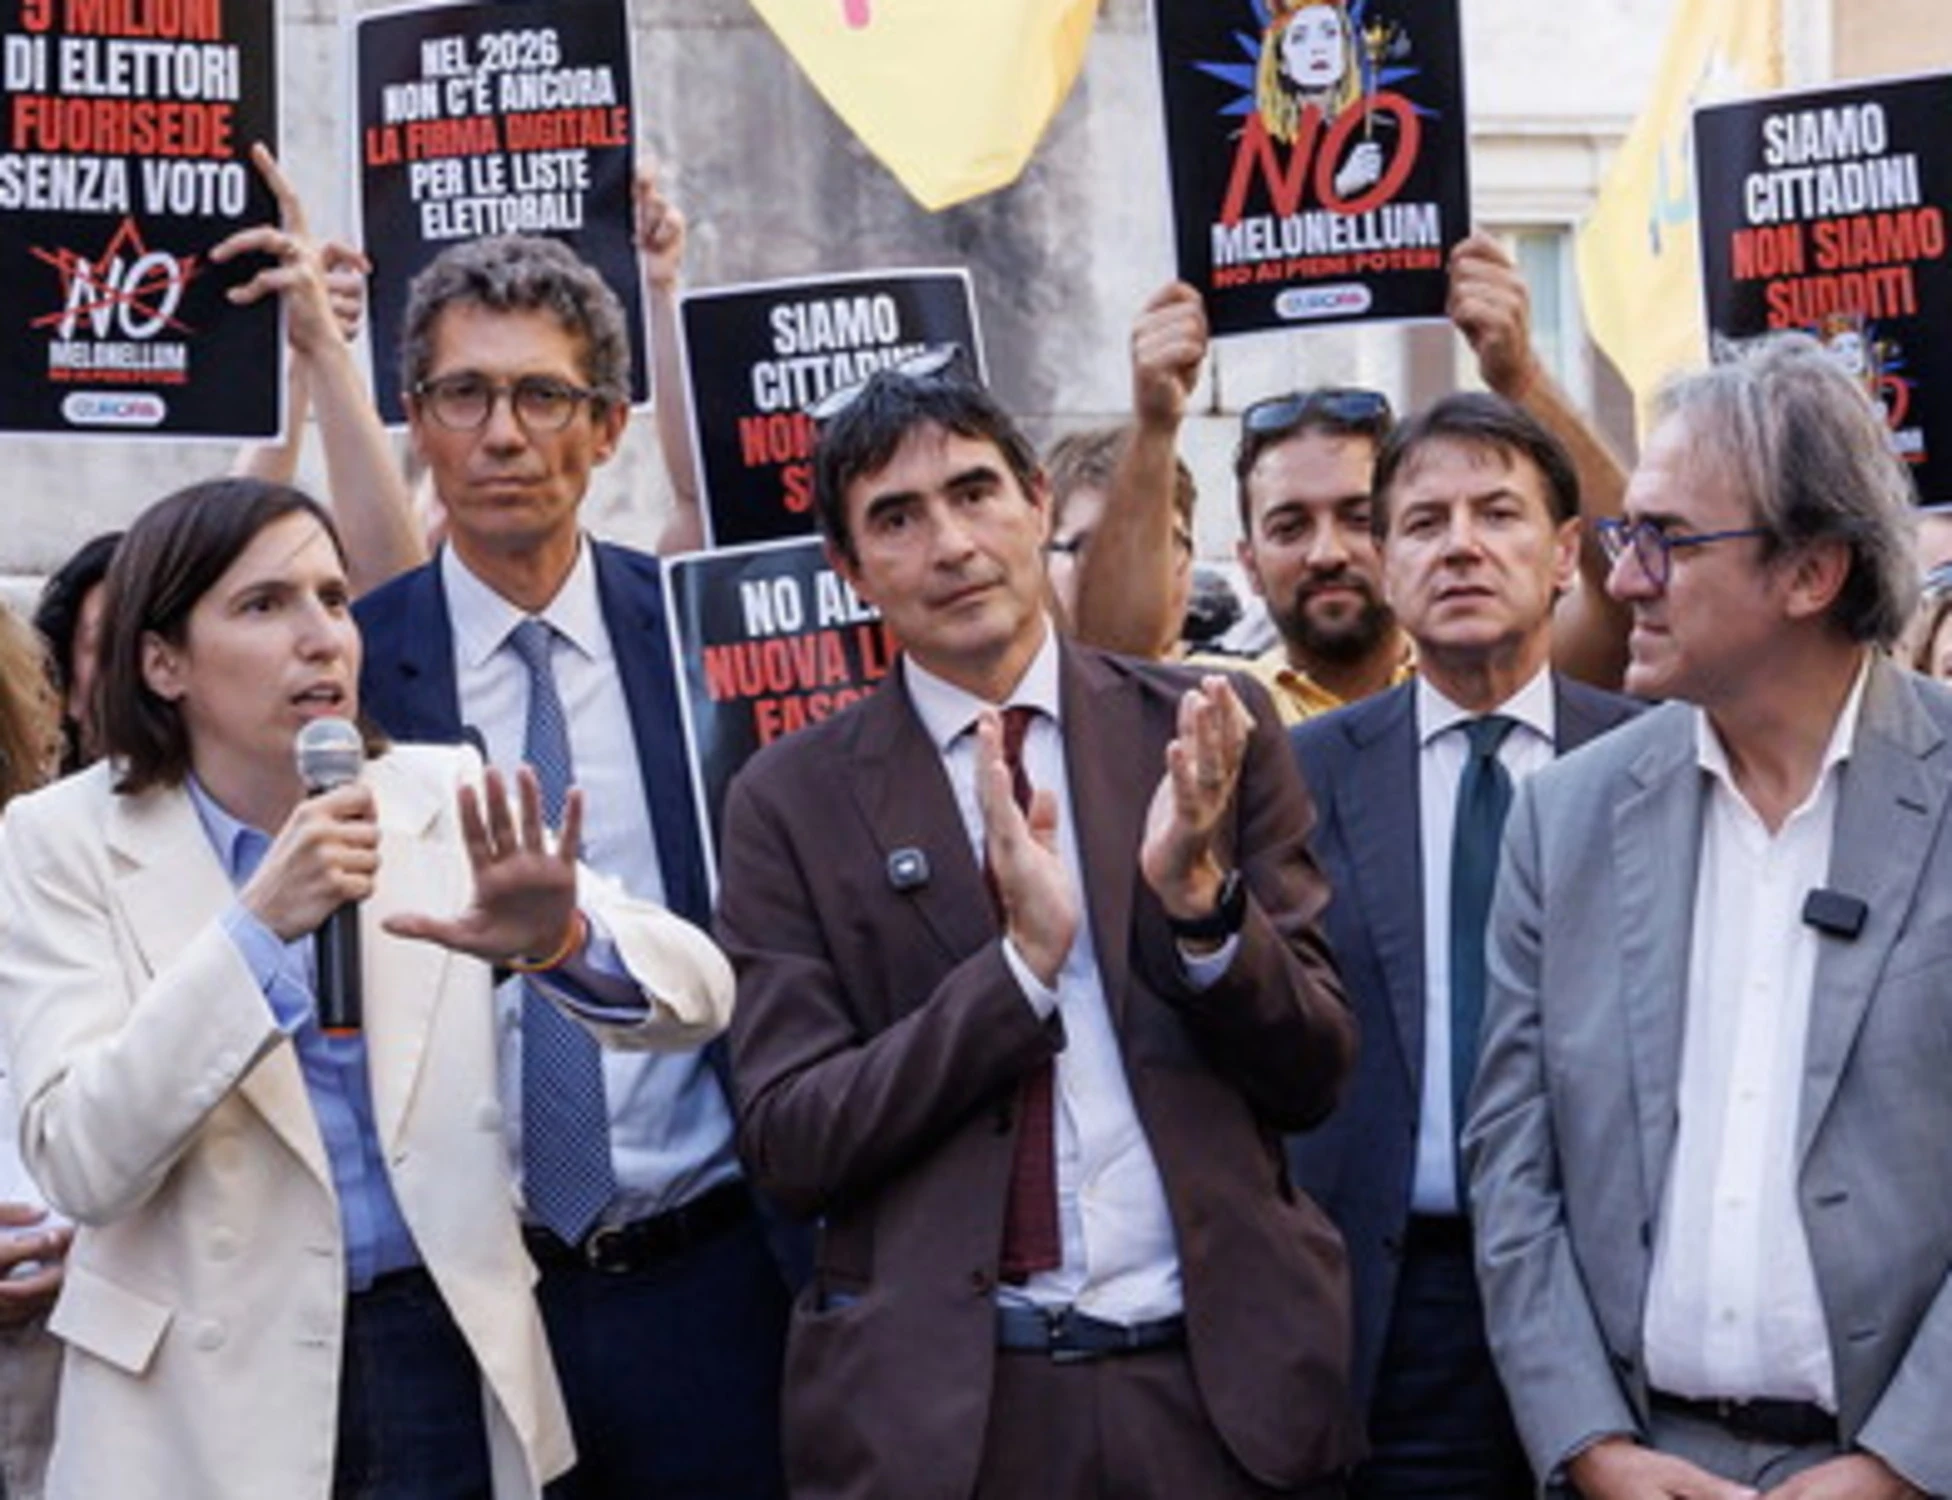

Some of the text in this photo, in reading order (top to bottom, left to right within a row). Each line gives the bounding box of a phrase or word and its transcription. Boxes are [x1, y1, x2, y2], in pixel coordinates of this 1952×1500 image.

[64, 0, 222, 41] MILIONI
[421, 28, 561, 77] NEL 2026
[4, 34, 240, 101] DI ELETTORI
[383, 80, 440, 124] NON
[501, 65, 617, 112] ANCORA
[13, 94, 235, 158] FUORISEDE
[366, 107, 628, 166] LA FIRMA DIGITALE
[1762, 102, 1888, 166] SIAMO
[0, 152, 247, 216] SENZA VOTO
[411, 149, 591, 200] PER LE LISTE
[1220, 90, 1422, 227] NO
[1746, 153, 1921, 225] CITTADINI
[421, 192, 583, 240] ELETTORALI
[1211, 202, 1441, 266] MELONELLUM
[1732, 207, 1945, 281] NON SIAMO
[57, 251, 183, 340] NO
[769, 293, 899, 354] SIAMO
[752, 343, 926, 412] CITTAD
[740, 570, 882, 637] NO AL
[704, 630, 849, 702] NUOVA
